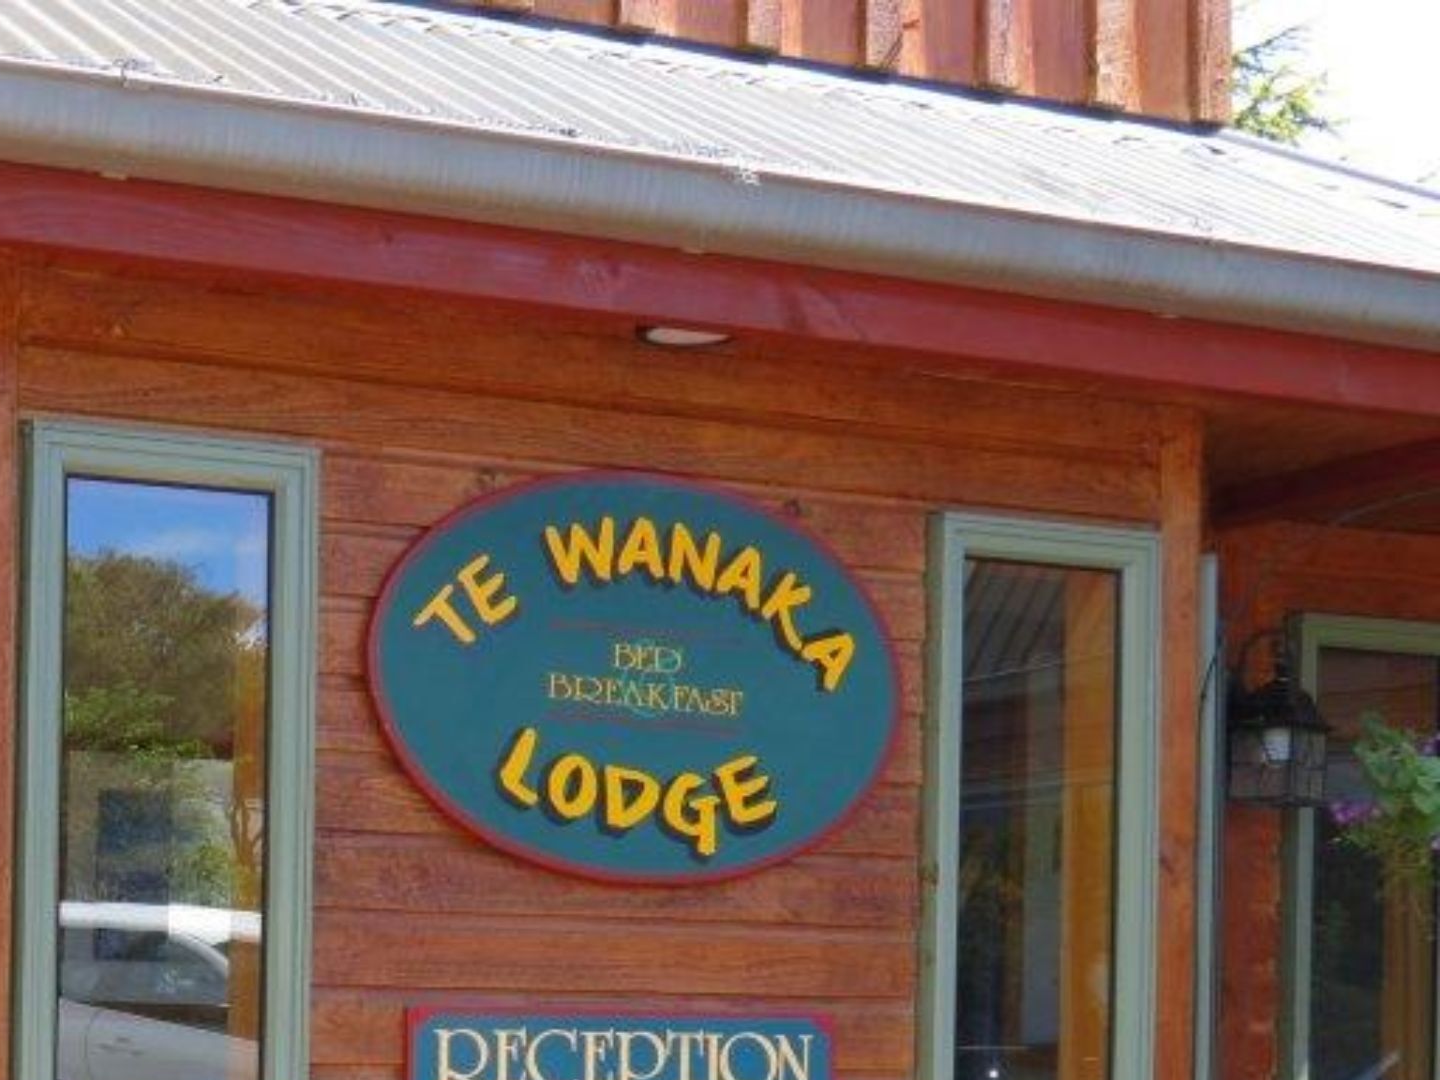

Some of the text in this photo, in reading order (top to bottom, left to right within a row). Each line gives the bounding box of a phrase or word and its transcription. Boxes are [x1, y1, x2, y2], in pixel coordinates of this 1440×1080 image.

[413, 516, 856, 691] TE WANAKA
[547, 672, 744, 715] BREAKFAST
[613, 642, 682, 674] BED
[499, 727, 777, 855] LODGE
